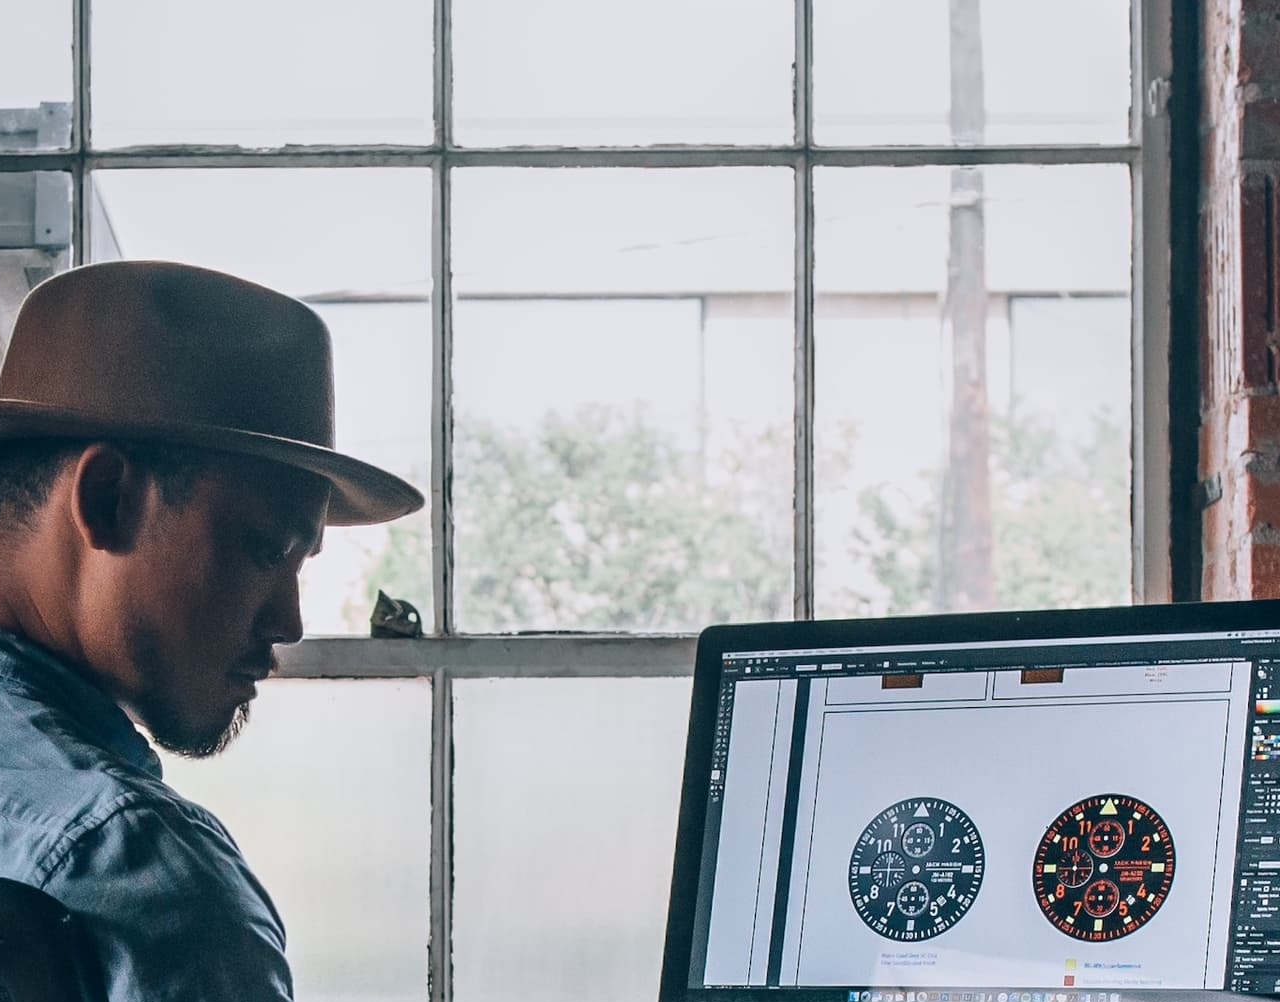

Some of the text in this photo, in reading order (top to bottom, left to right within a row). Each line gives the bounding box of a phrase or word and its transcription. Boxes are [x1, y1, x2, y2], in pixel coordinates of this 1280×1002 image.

[893, 823, 905, 837] 11
[939, 822, 945, 837] 1
[1079, 820, 1092, 835] 11
[1128, 820, 1133, 835] 1
[876, 839, 892, 854] 10
[951, 838, 961, 853] 2
[1062, 836, 1078, 851] 10
[1141, 835, 1150, 851] 2
[870, 884, 879, 900] 8
[947, 884, 956, 899] 4
[1056, 883, 1065, 898] 8
[1136, 883, 1146, 898] 4
[886, 901, 895, 917] 7
[930, 901, 938, 916] 5
[1073, 901, 1082, 916] 7
[1119, 901, 1128, 916] 5
